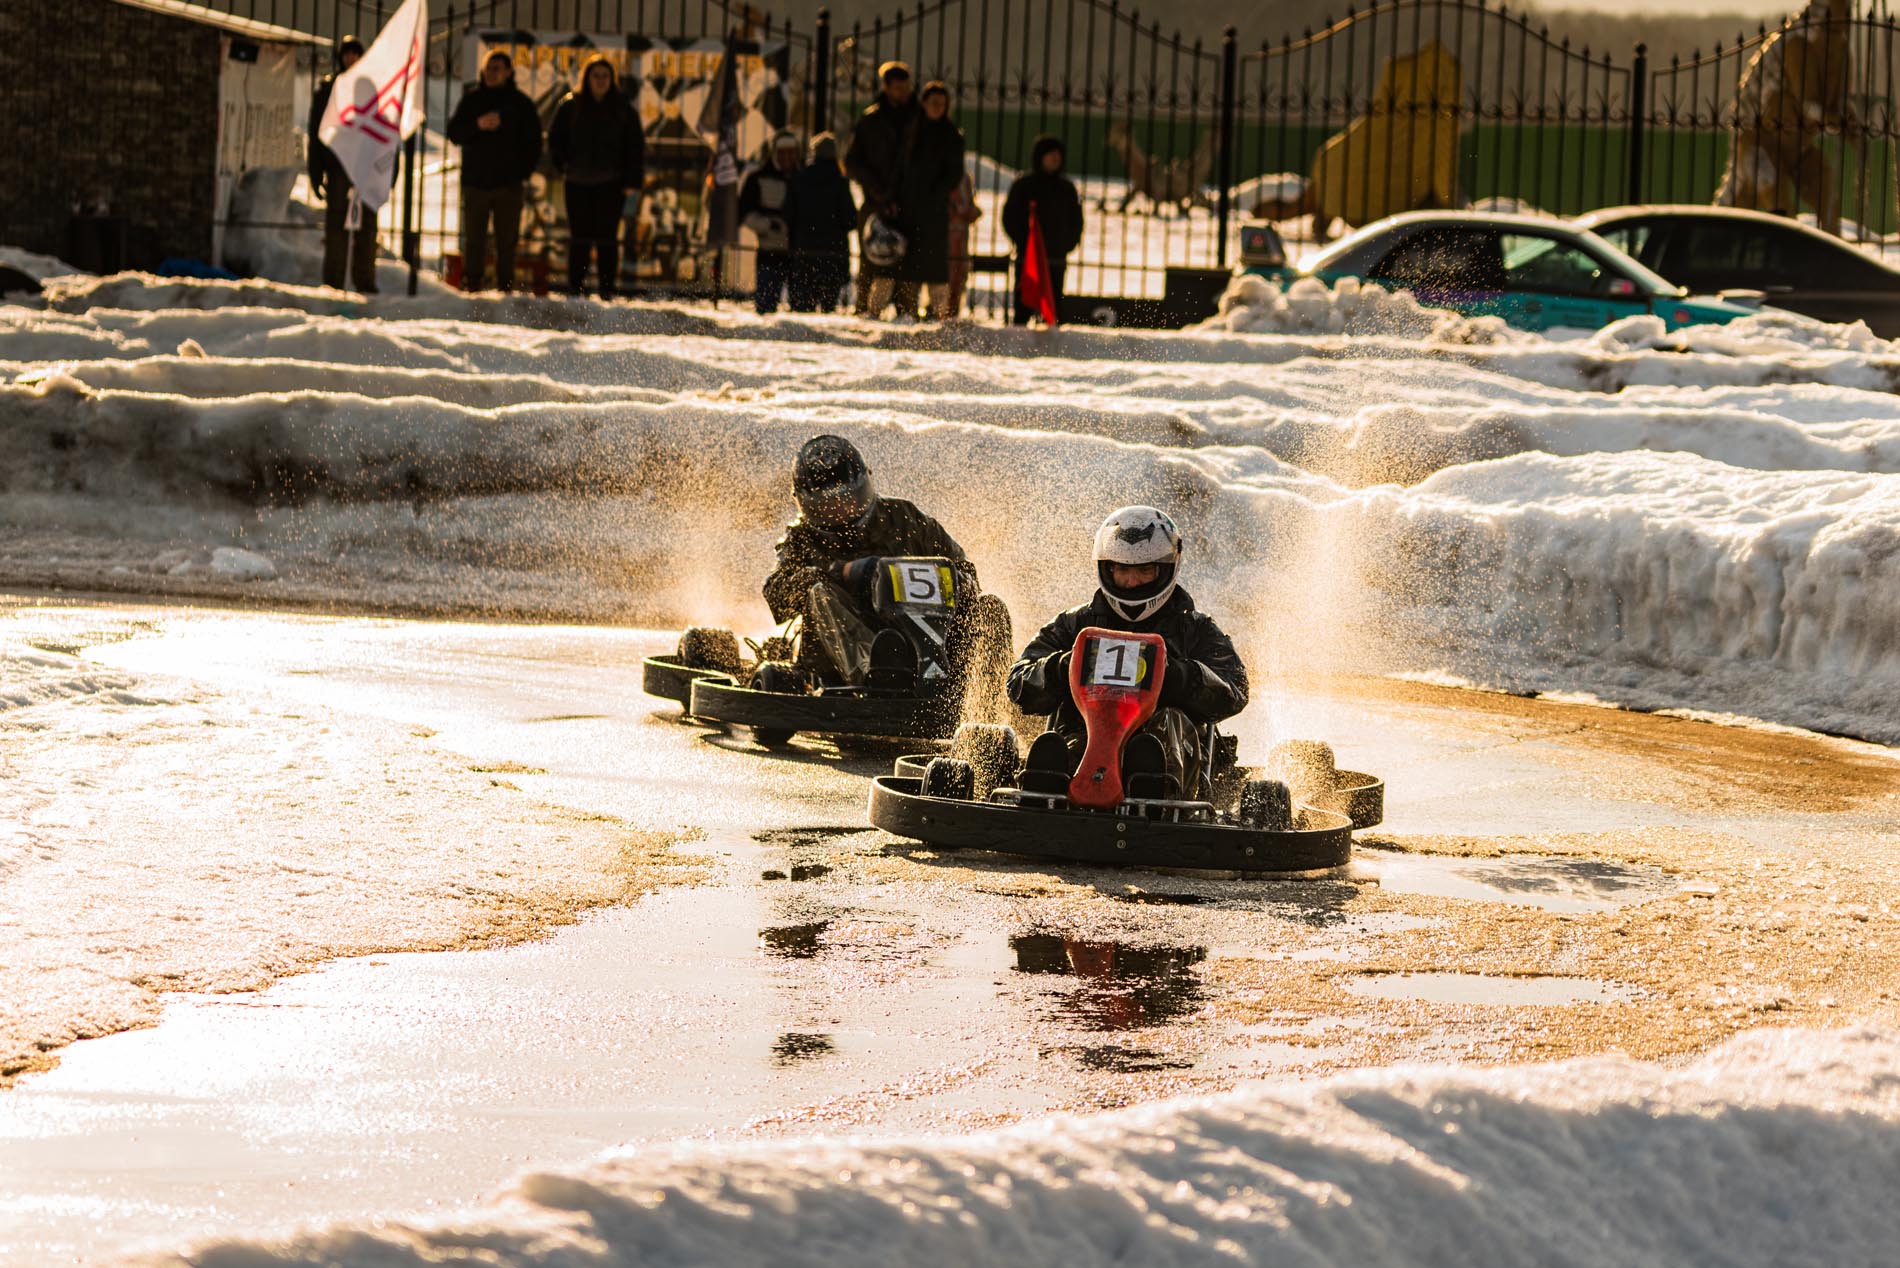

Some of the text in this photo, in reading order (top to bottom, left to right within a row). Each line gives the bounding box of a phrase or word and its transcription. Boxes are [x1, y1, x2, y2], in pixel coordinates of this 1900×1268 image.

[653, 51, 765, 79] ЦЕНР
[908, 568, 936, 599] 5
[1102, 645, 1131, 681] 1
